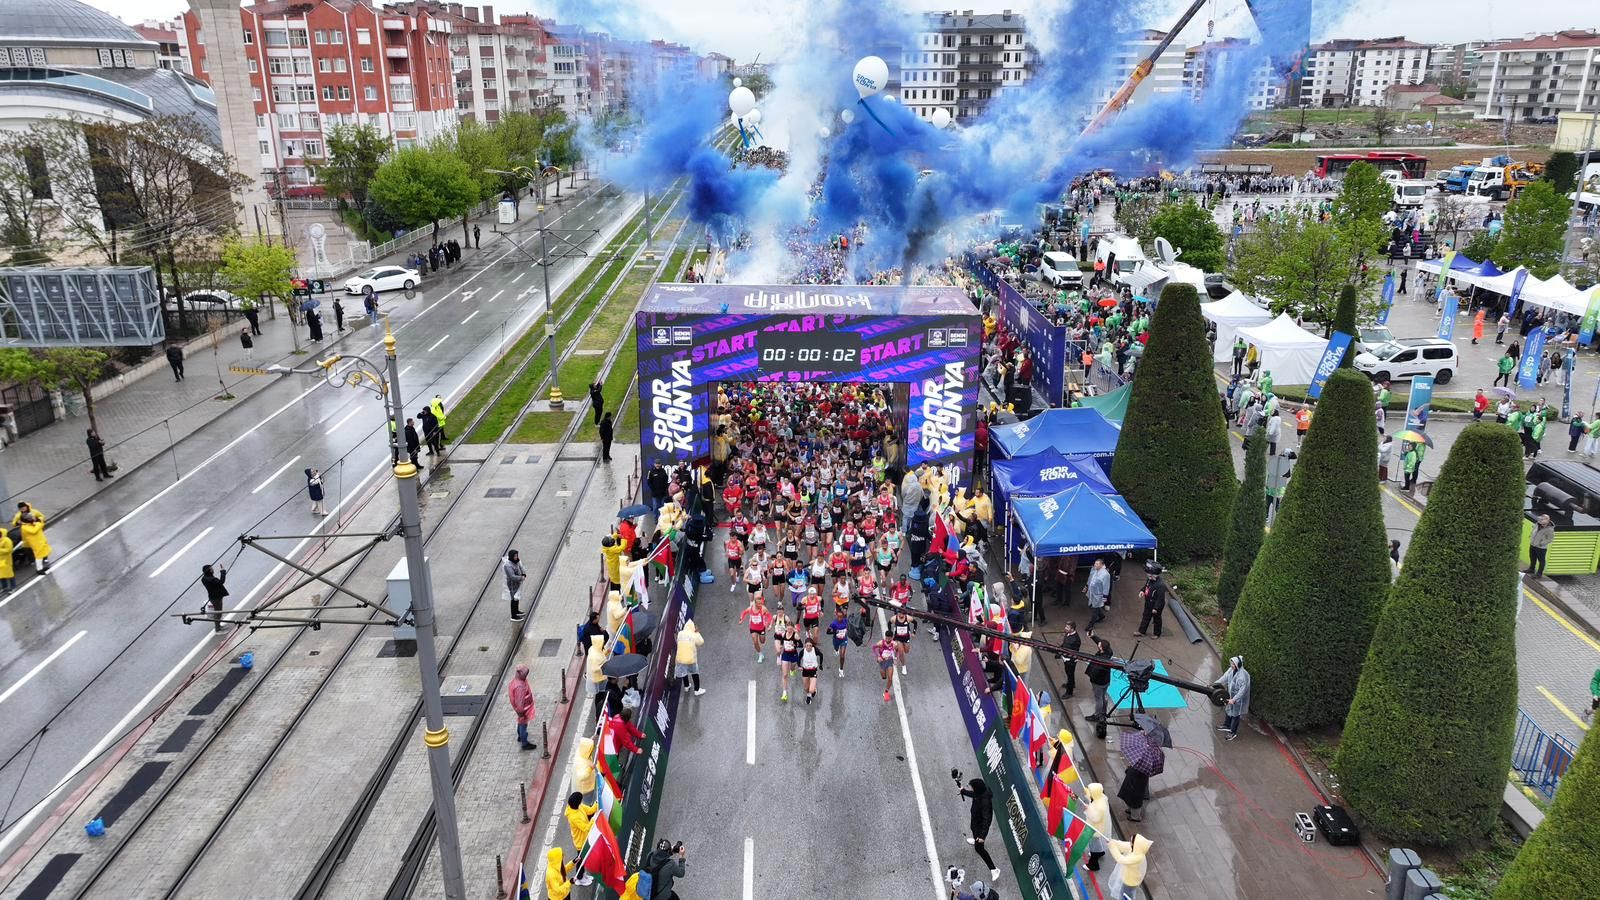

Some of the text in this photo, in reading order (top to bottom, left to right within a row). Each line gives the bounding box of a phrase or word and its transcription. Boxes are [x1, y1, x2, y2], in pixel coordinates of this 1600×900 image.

[691, 330, 758, 363] START
[860, 333, 925, 365] START
[1324, 346, 1345, 377] KONYA
[1318, 350, 1334, 376] SPOR
[652, 378, 674, 454] SPOR
[666, 359, 693, 452] KONYA
[922, 380, 943, 454] SPOR
[936, 361, 965, 453] KONYA
[1040, 466, 1068, 476] SPOR
[1040, 472, 1077, 482] KONYA
